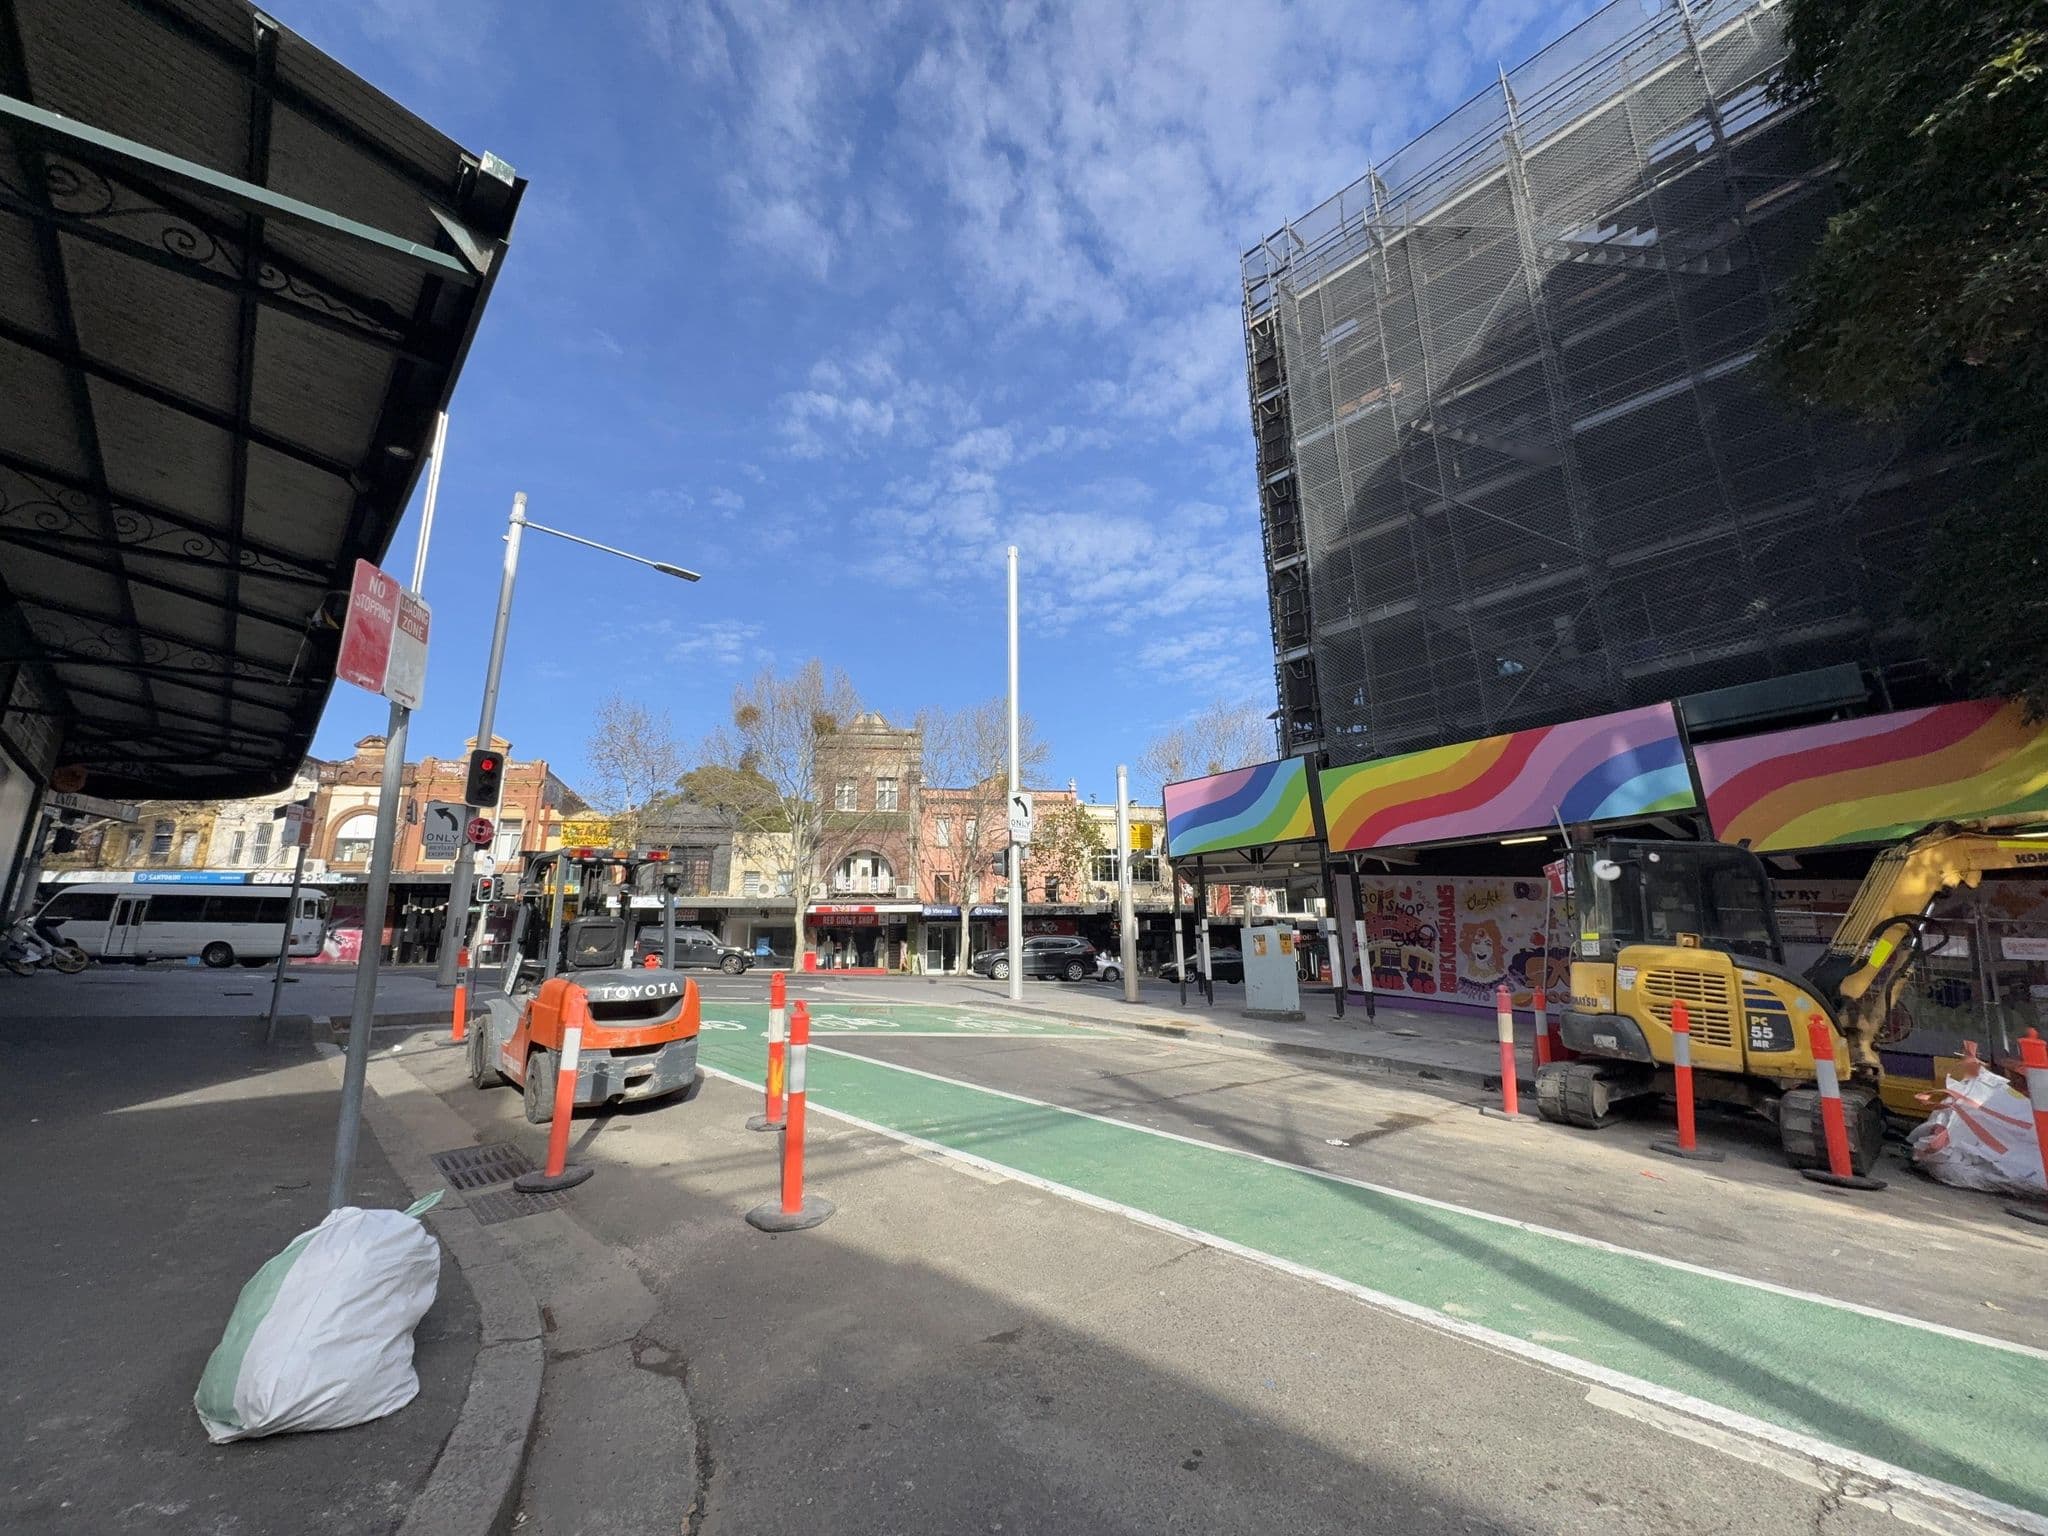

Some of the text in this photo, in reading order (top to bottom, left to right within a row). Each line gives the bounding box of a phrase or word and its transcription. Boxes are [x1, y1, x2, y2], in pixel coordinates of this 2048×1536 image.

[368, 575, 386, 599] NO
[354, 593, 393, 624] STOPPING
[400, 594, 429, 625] LOADING
[401, 614, 425, 641] ZONE
[469, 824, 492, 836] STOP
[1011, 819, 1030, 828] ONLY
[426, 832, 459, 842] ONLY
[1386, 900, 1425, 916] SHOP
[823, 915, 834, 925] RED
[858, 915, 875, 925] SHOP
[601, 982, 678, 999] TOYOTA
[1751, 1015, 1768, 1026] PC
[1751, 1026, 1774, 1039] 55
